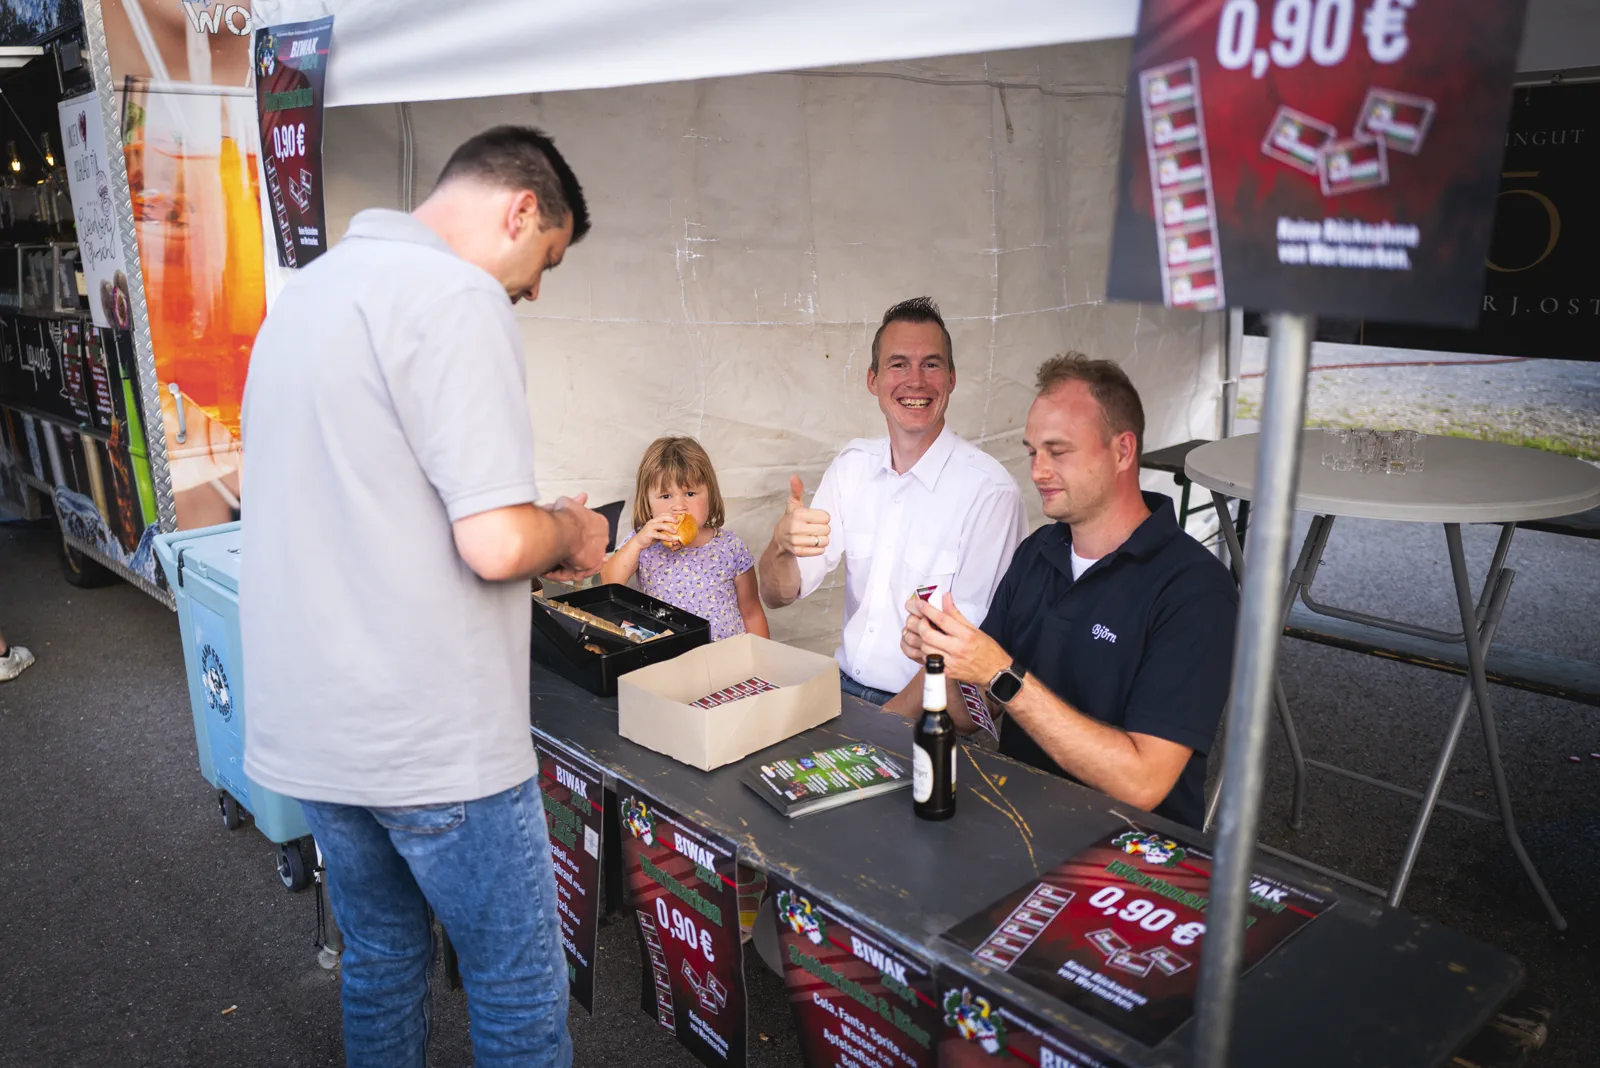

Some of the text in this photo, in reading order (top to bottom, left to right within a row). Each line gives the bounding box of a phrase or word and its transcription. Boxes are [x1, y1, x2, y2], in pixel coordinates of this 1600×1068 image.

[290, 37, 319, 58] BIWAK
[1216, 0, 1416, 78] 0,90 €
[273, 123, 305, 162] 0,90 €
[1504, 129, 1585, 147] INGUT
[1092, 623, 1117, 643] Björn
[555, 764, 588, 800] BIWAK
[674, 832, 717, 874] BIWAK
[638, 851, 723, 928] Wertmarken
[655, 897, 716, 963] 0,90 €
[1088, 886, 1208, 946] 0,90 €
[850, 935, 909, 987] BIWAK
[812, 991, 839, 1018] Cola,
[837, 1006, 870, 1037] Fanta,
[868, 1026, 901, 1057] Sprite
[840, 1022, 877, 1056] Wasser
[823, 1027, 883, 1068] Apfelsaftsch
